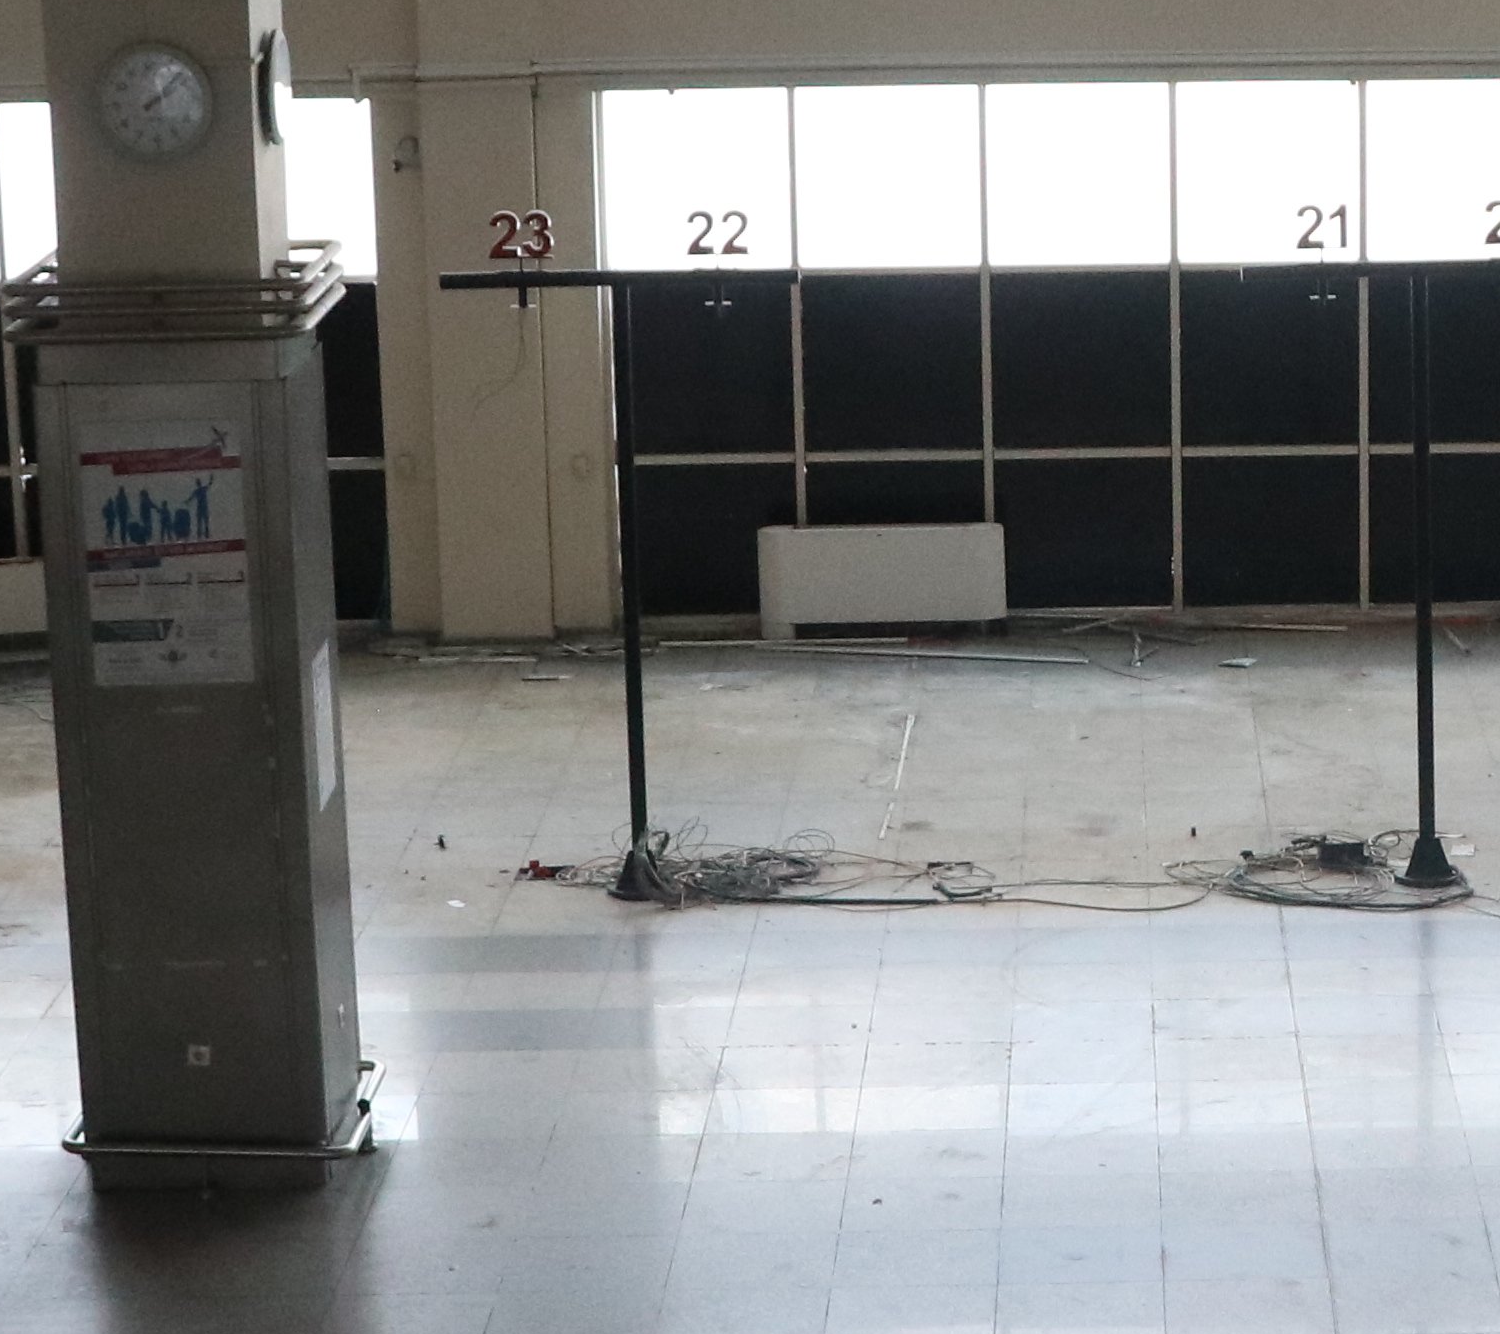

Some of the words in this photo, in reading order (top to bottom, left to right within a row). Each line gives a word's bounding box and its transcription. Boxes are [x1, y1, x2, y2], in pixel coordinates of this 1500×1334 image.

[489, 210, 554, 259] 23
[687, 211, 749, 255] 22
[1297, 204, 1347, 249] 21
